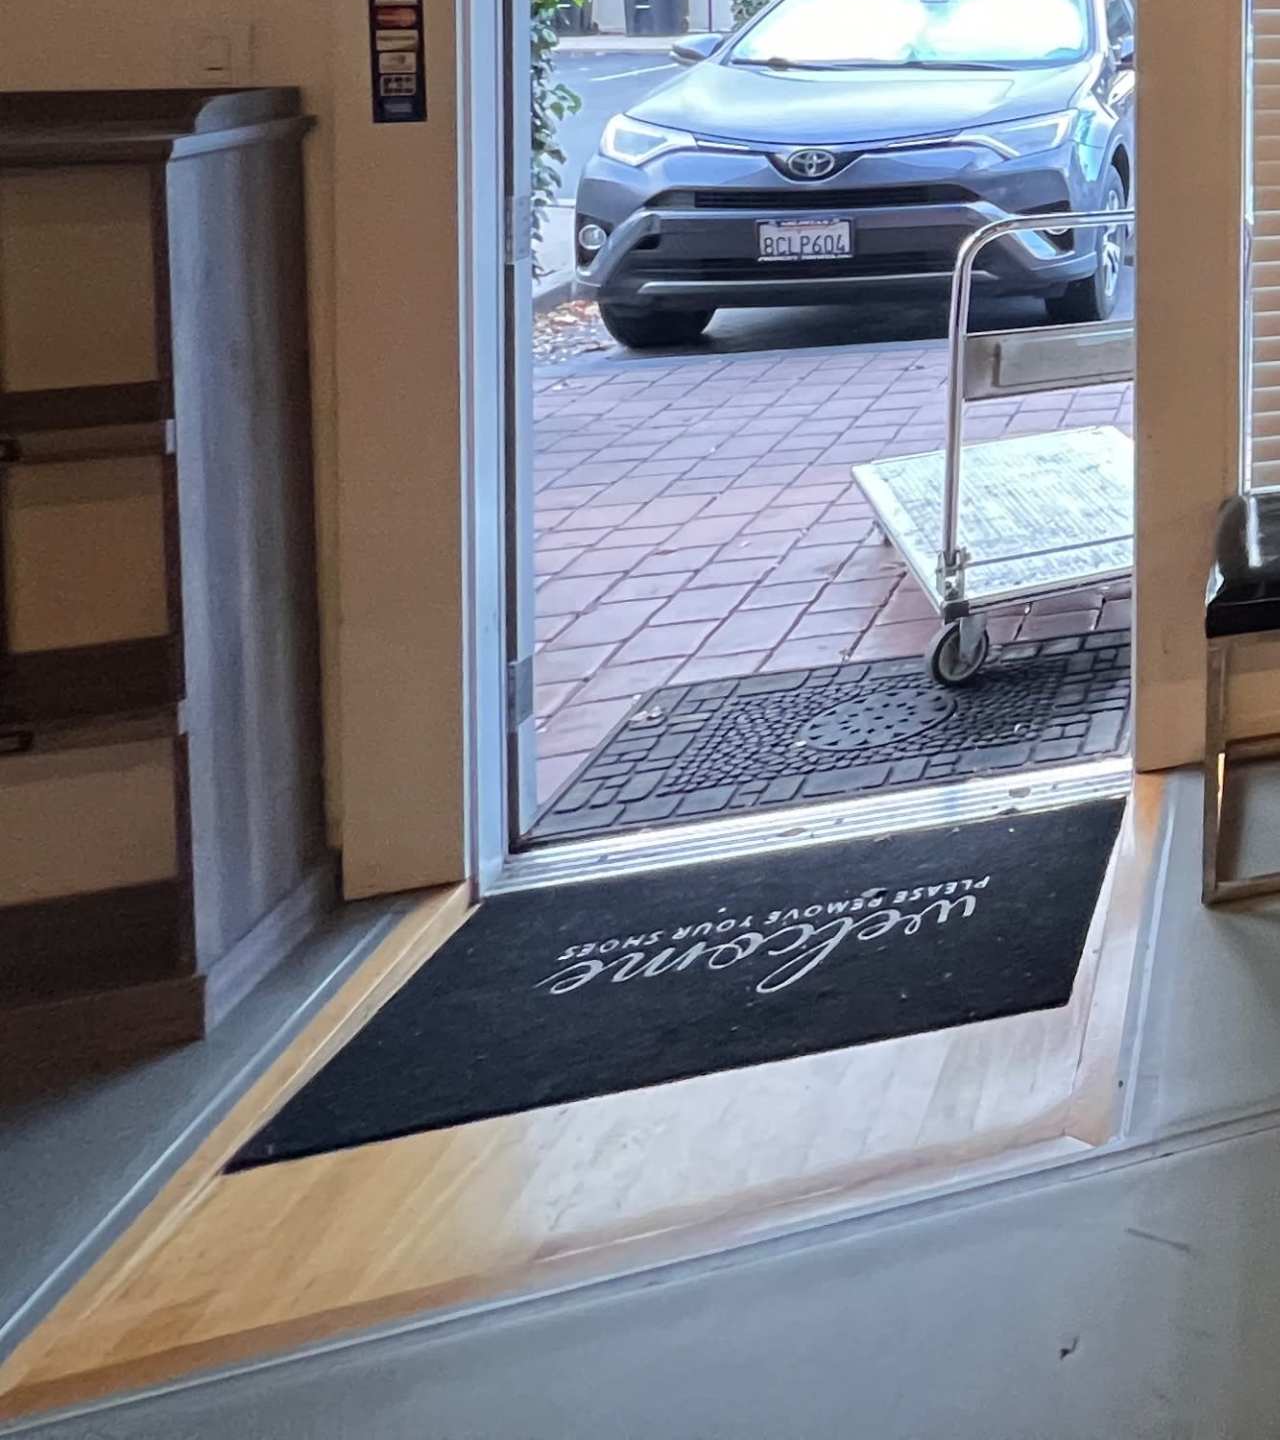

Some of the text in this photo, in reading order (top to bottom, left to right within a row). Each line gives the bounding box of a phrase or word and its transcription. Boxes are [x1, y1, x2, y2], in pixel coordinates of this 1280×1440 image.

[763, 234, 846, 257] 8CLP604
[533, 894, 977, 994] welcome
[557, 875, 991, 962] PLEASE REMOVE YOUR SHOES
